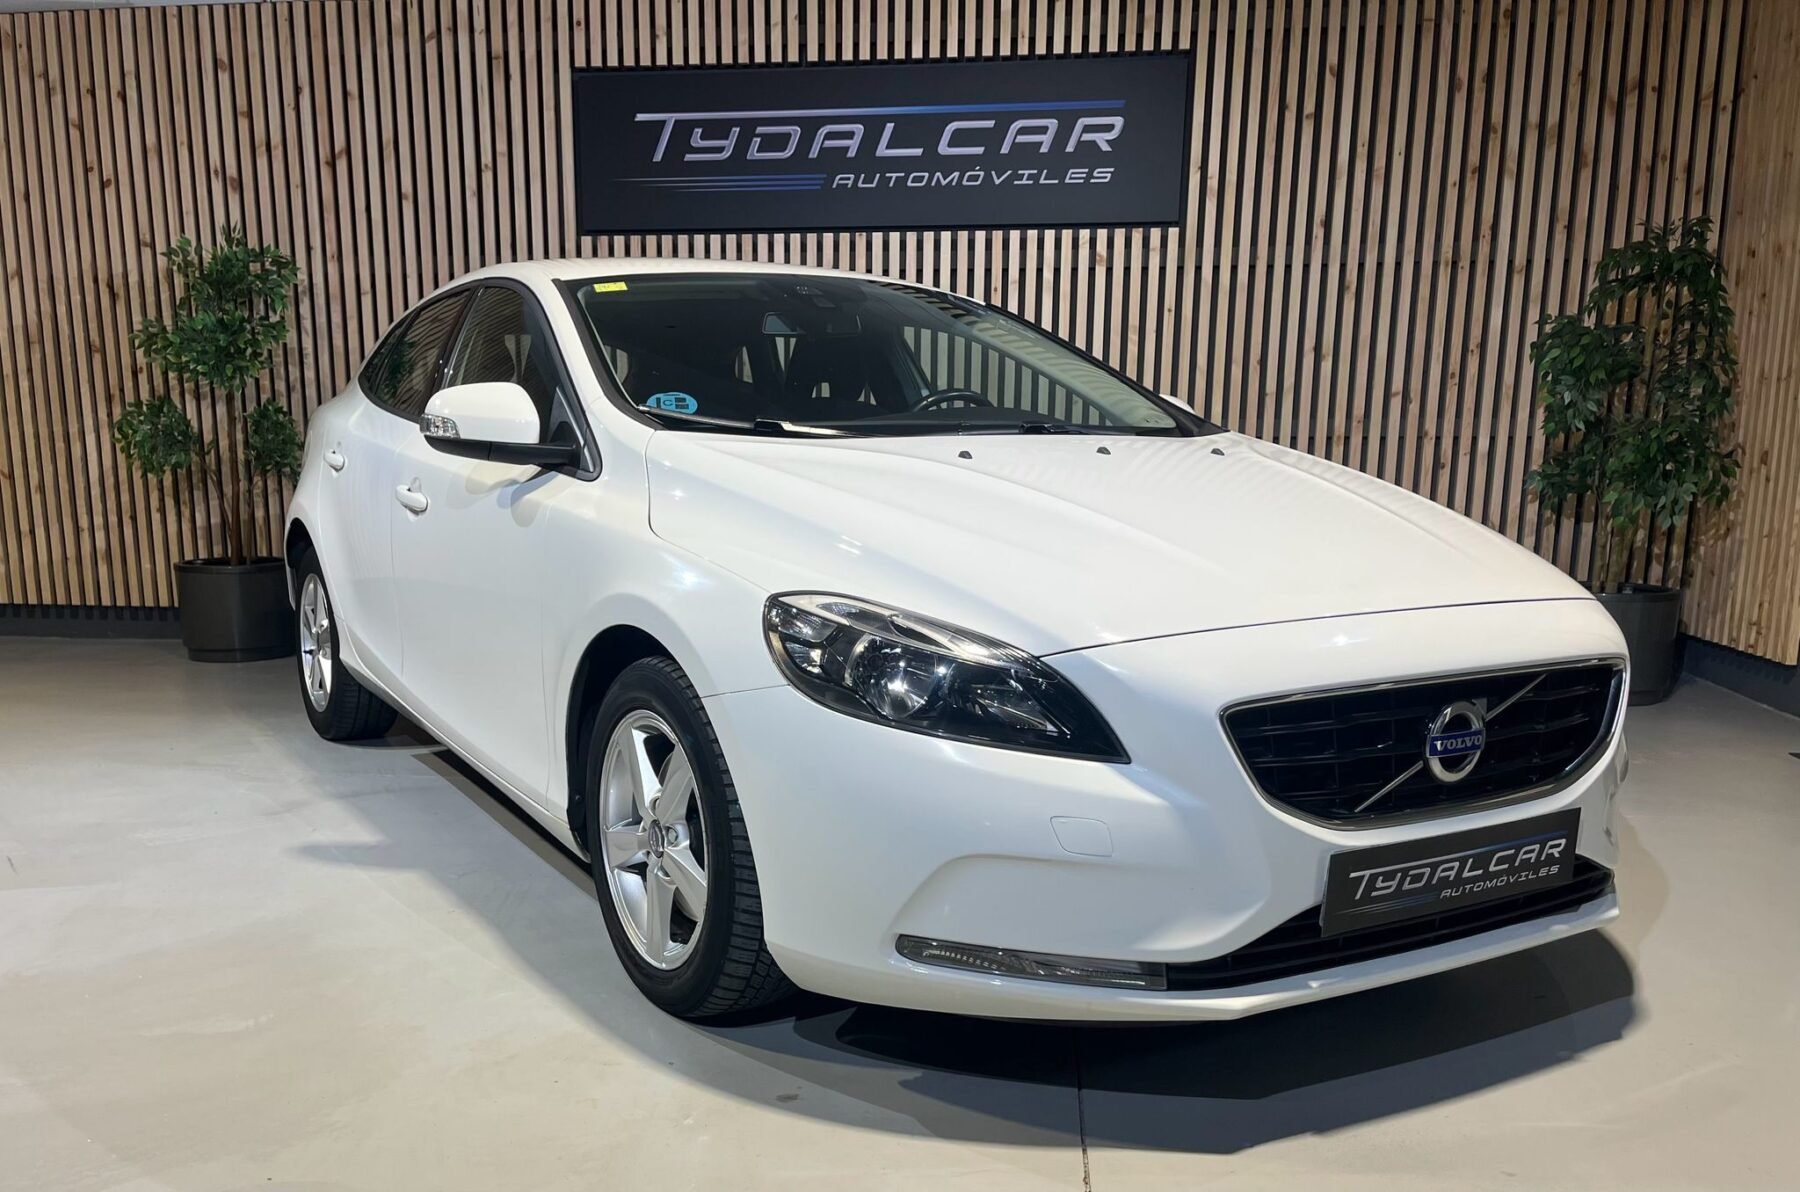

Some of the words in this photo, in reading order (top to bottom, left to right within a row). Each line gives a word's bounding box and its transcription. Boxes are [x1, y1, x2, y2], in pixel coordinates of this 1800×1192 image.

[634, 102, 1126, 162] TYDALCAR
[832, 167, 1115, 189] AUTOMÓVILES
[1433, 735, 1482, 751] VOLVO
[1349, 837, 1567, 900] TYDALCAR
[1440, 865, 1560, 899] AUTOMÓVILES
